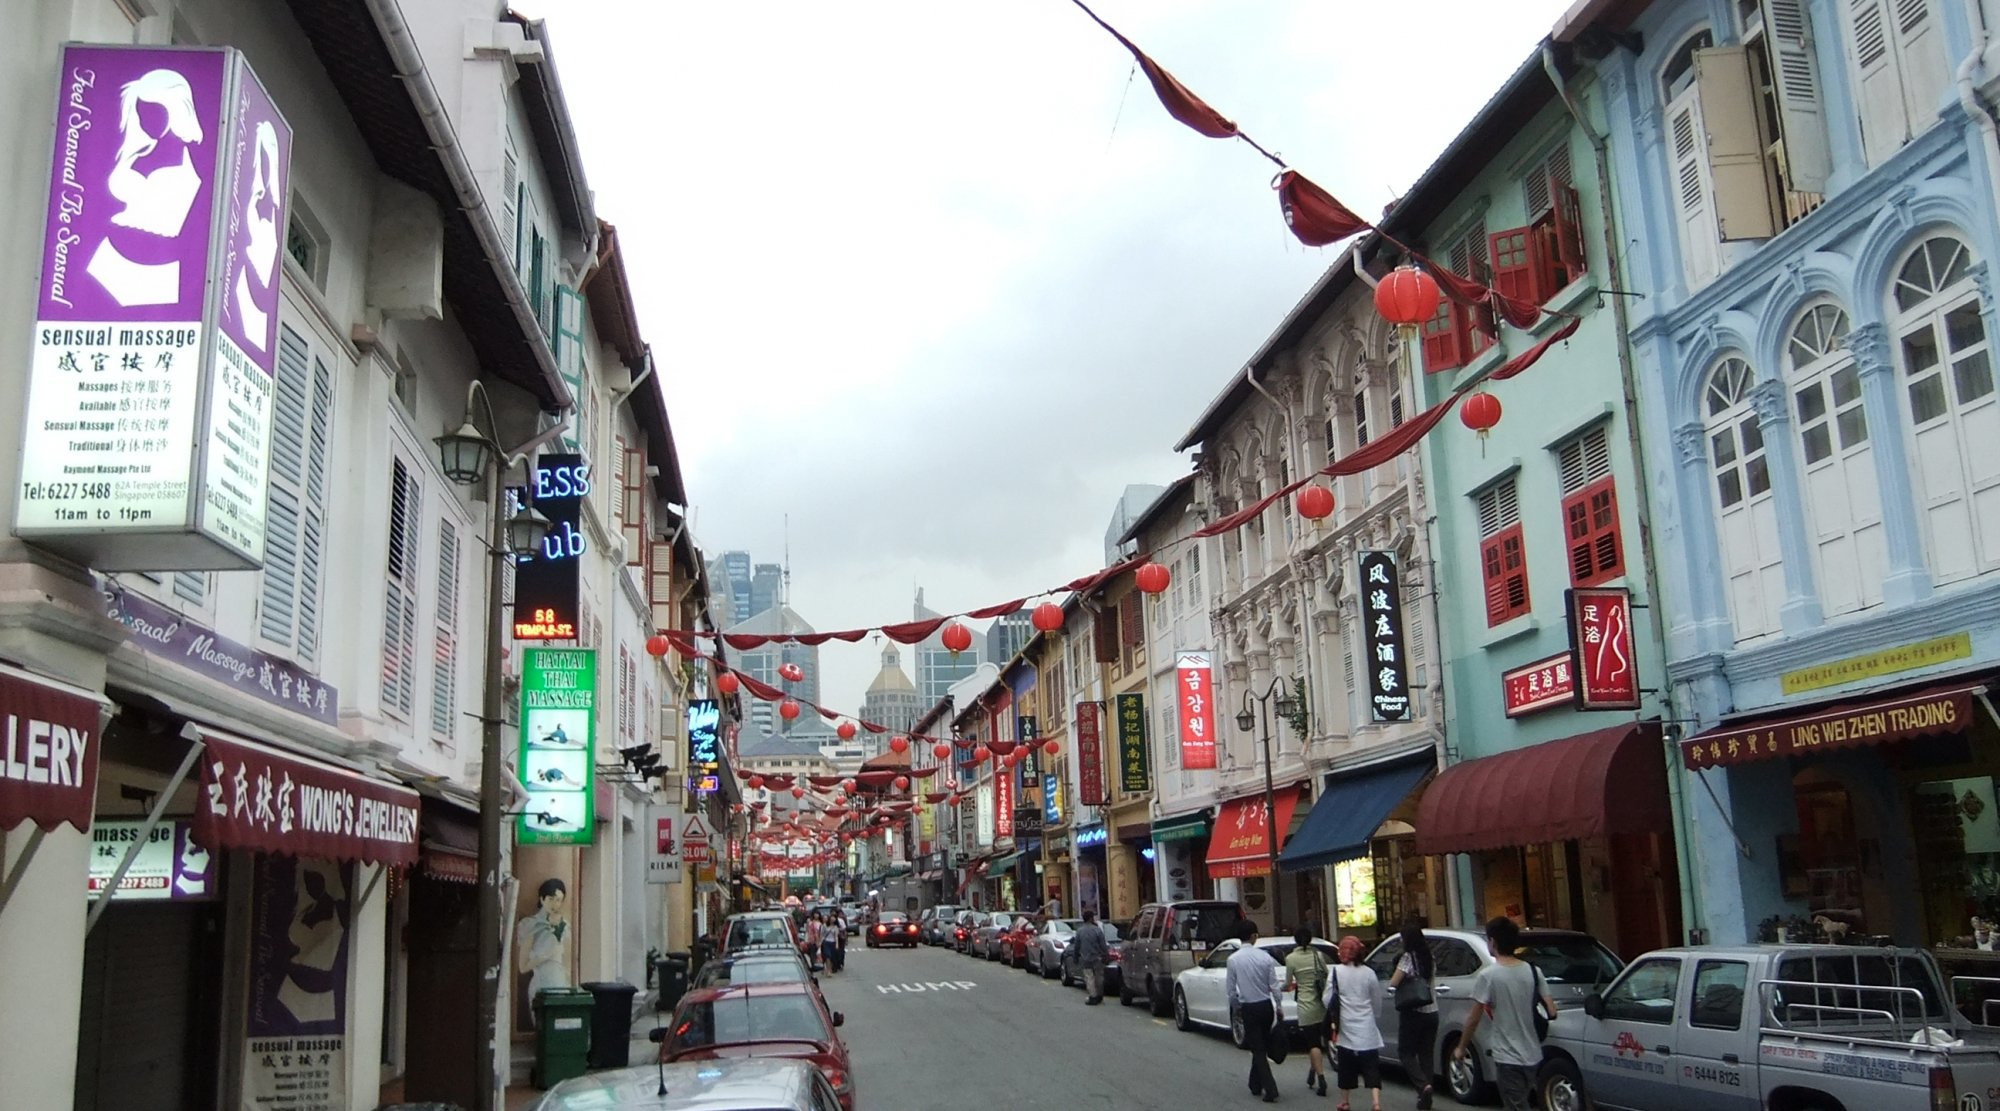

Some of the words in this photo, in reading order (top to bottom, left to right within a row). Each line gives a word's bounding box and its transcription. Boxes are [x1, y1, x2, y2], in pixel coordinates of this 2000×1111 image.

[62, 112, 89, 194] Sensual
[51, 226, 80, 309] Sensual
[42, 325, 112, 347] sensual
[119, 328, 196, 348] massage
[57, 350, 176, 374] 感官按摩
[78, 381, 118, 394] Massages
[79, 401, 117, 412] Available
[44, 420, 78, 432] Sensual
[80, 421, 115, 433] Massage
[69, 440, 114, 452] Traditional
[63, 464, 96, 476] Raymond
[97, 465, 128, 476] Massage
[128, 465, 141, 475] Pte
[23, 482, 46, 501] Tel:
[47, 483, 78, 500] 6227
[82, 483, 111, 500] 5488
[54, 508, 88, 521] 11am
[97, 508, 111, 520] to
[119, 507, 152, 522] 11pm
[535, 608, 555, 624] 58
[1583, 604, 1601, 643] 足浴
[1369, 563, 1399, 692] 风波庄酒家
[187, 634, 256, 682] Massage
[535, 652, 586, 670] HATYAI
[543, 671, 577, 689] THAI
[527, 690, 592, 708] MASSAGE
[1184, 670, 1205, 737] 금강원
[1374, 695, 1408, 704] Chinese
[1381, 703, 1402, 711] Food
[1791, 724, 1820, 748] LING
[1821, 719, 1847, 743] WEI
[1850, 711, 1887, 739] ZHEN
[1888, 700, 1956, 732] TRADING
[301, 783, 354, 836] WONG'S
[355, 796, 418, 844] JEWELLERY
[93, 827, 170, 843] massge
[683, 846, 707, 858] SLOW
[140, 878, 164, 888] 5488
[876, 980, 978, 994] HUMP
[252, 1037, 293, 1053] sensual
[296, 1039, 342, 1051] massage
[1694, 1066, 1717, 1082] 6444
